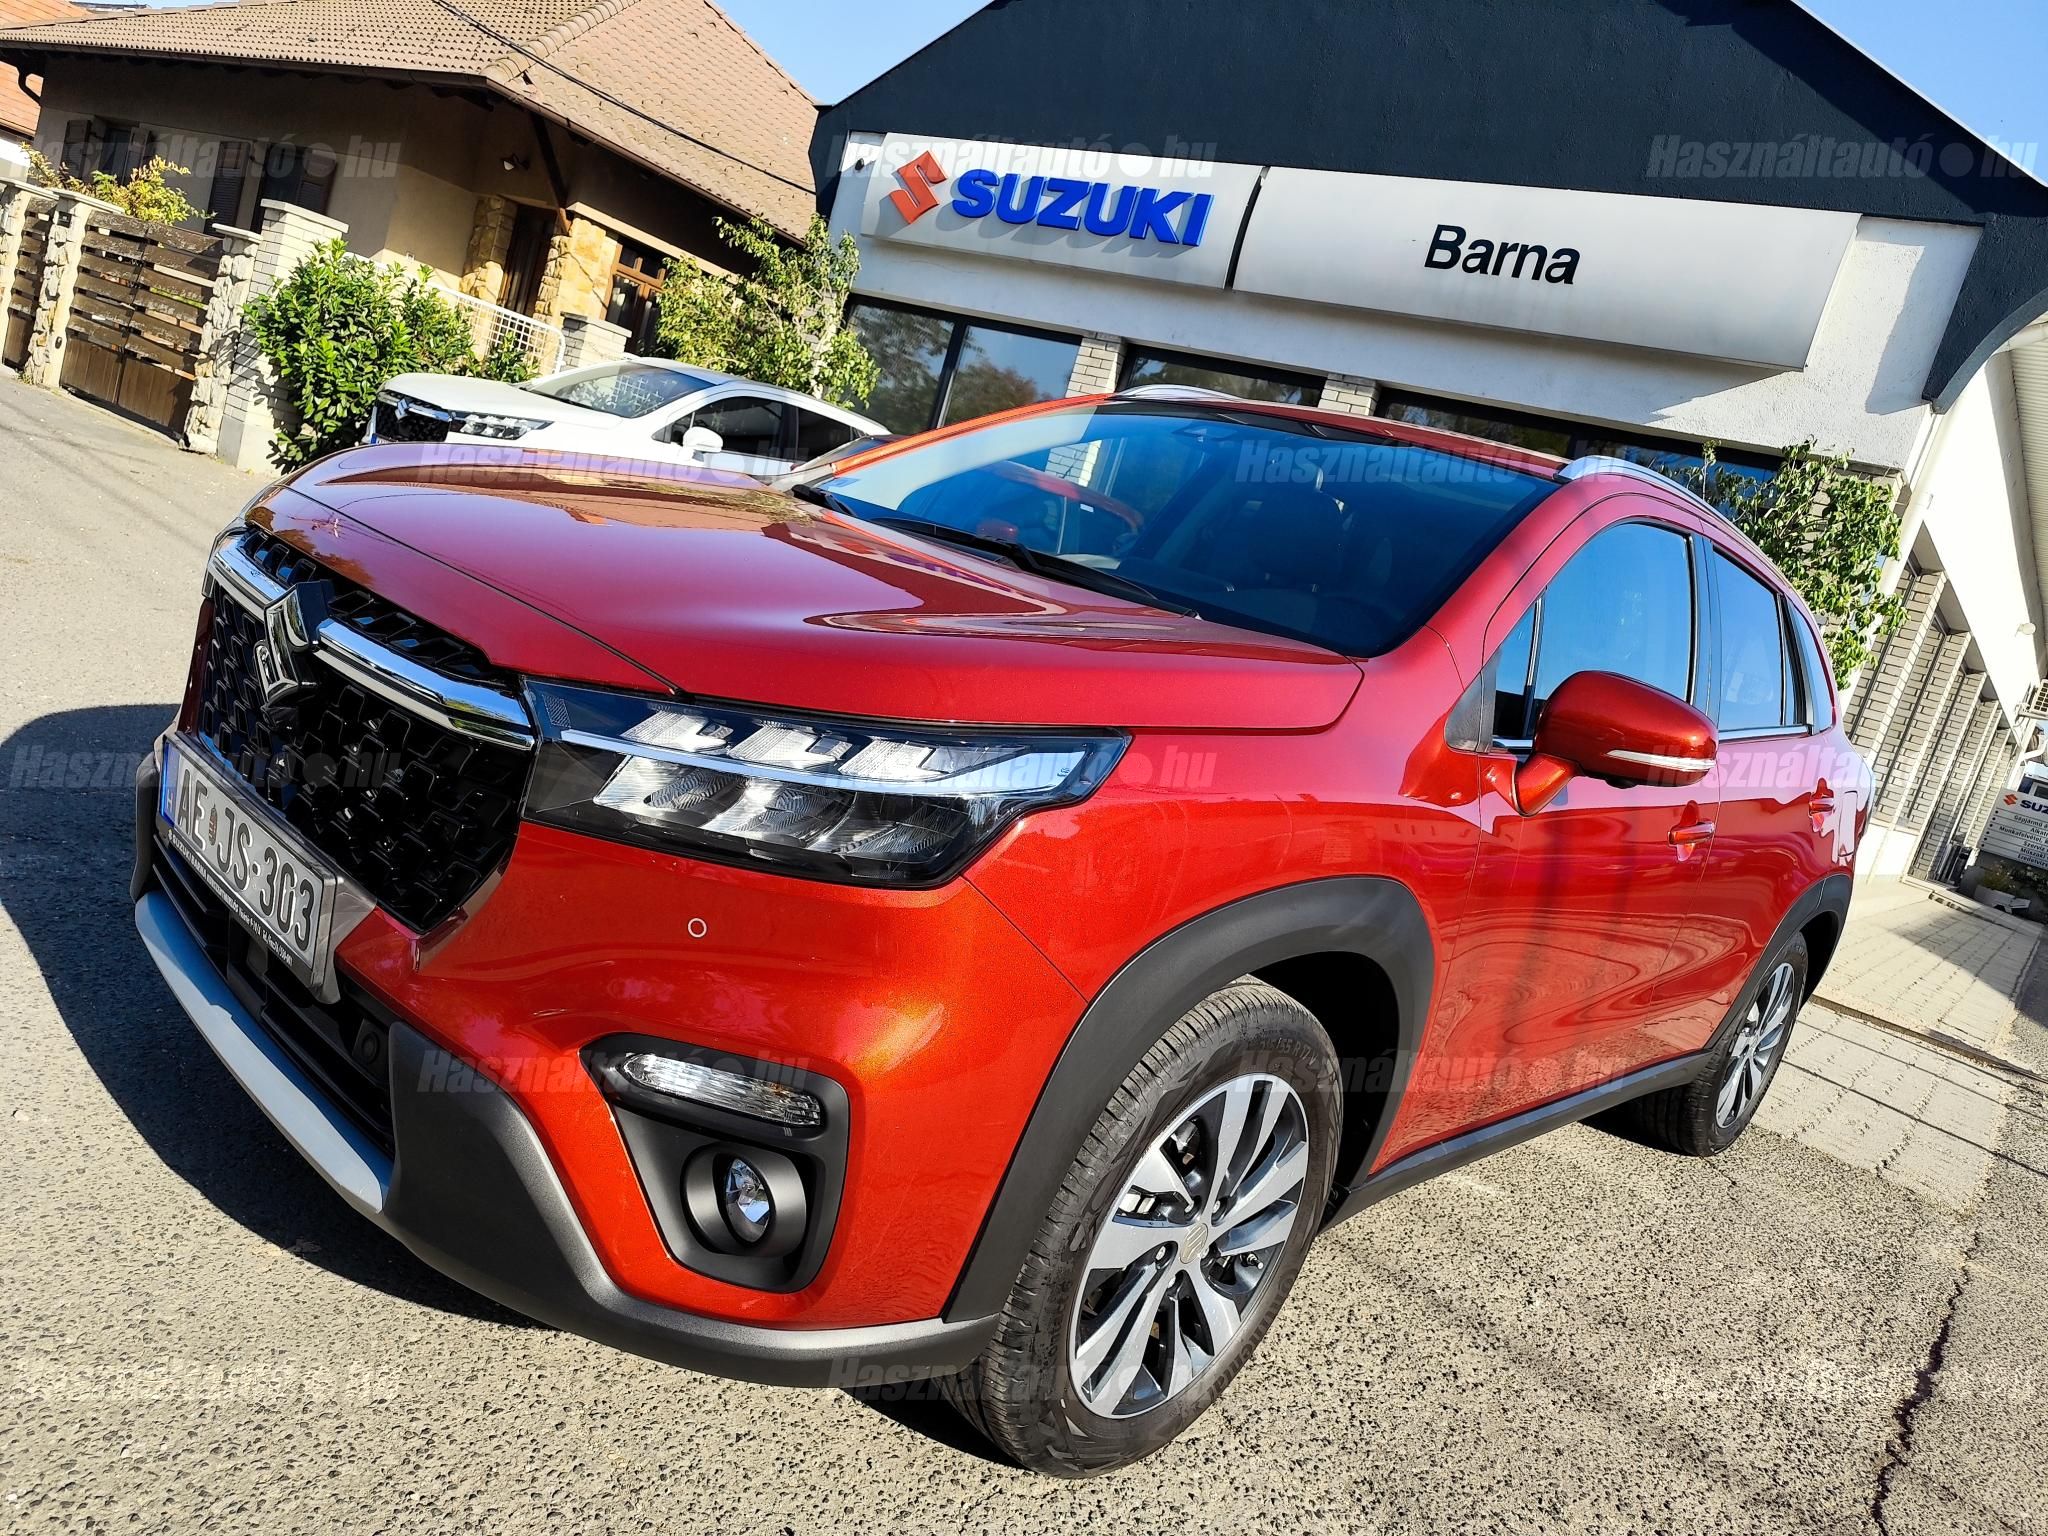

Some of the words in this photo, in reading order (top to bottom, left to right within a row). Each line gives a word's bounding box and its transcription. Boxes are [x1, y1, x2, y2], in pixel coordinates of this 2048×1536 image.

[952, 169, 1215, 247] SUZUKI
[1424, 224, 1581, 286] Barna
[177, 768, 209, 853] AE
[172, 833, 192, 862] SUZUKI
[191, 855, 207, 880] BARNA
